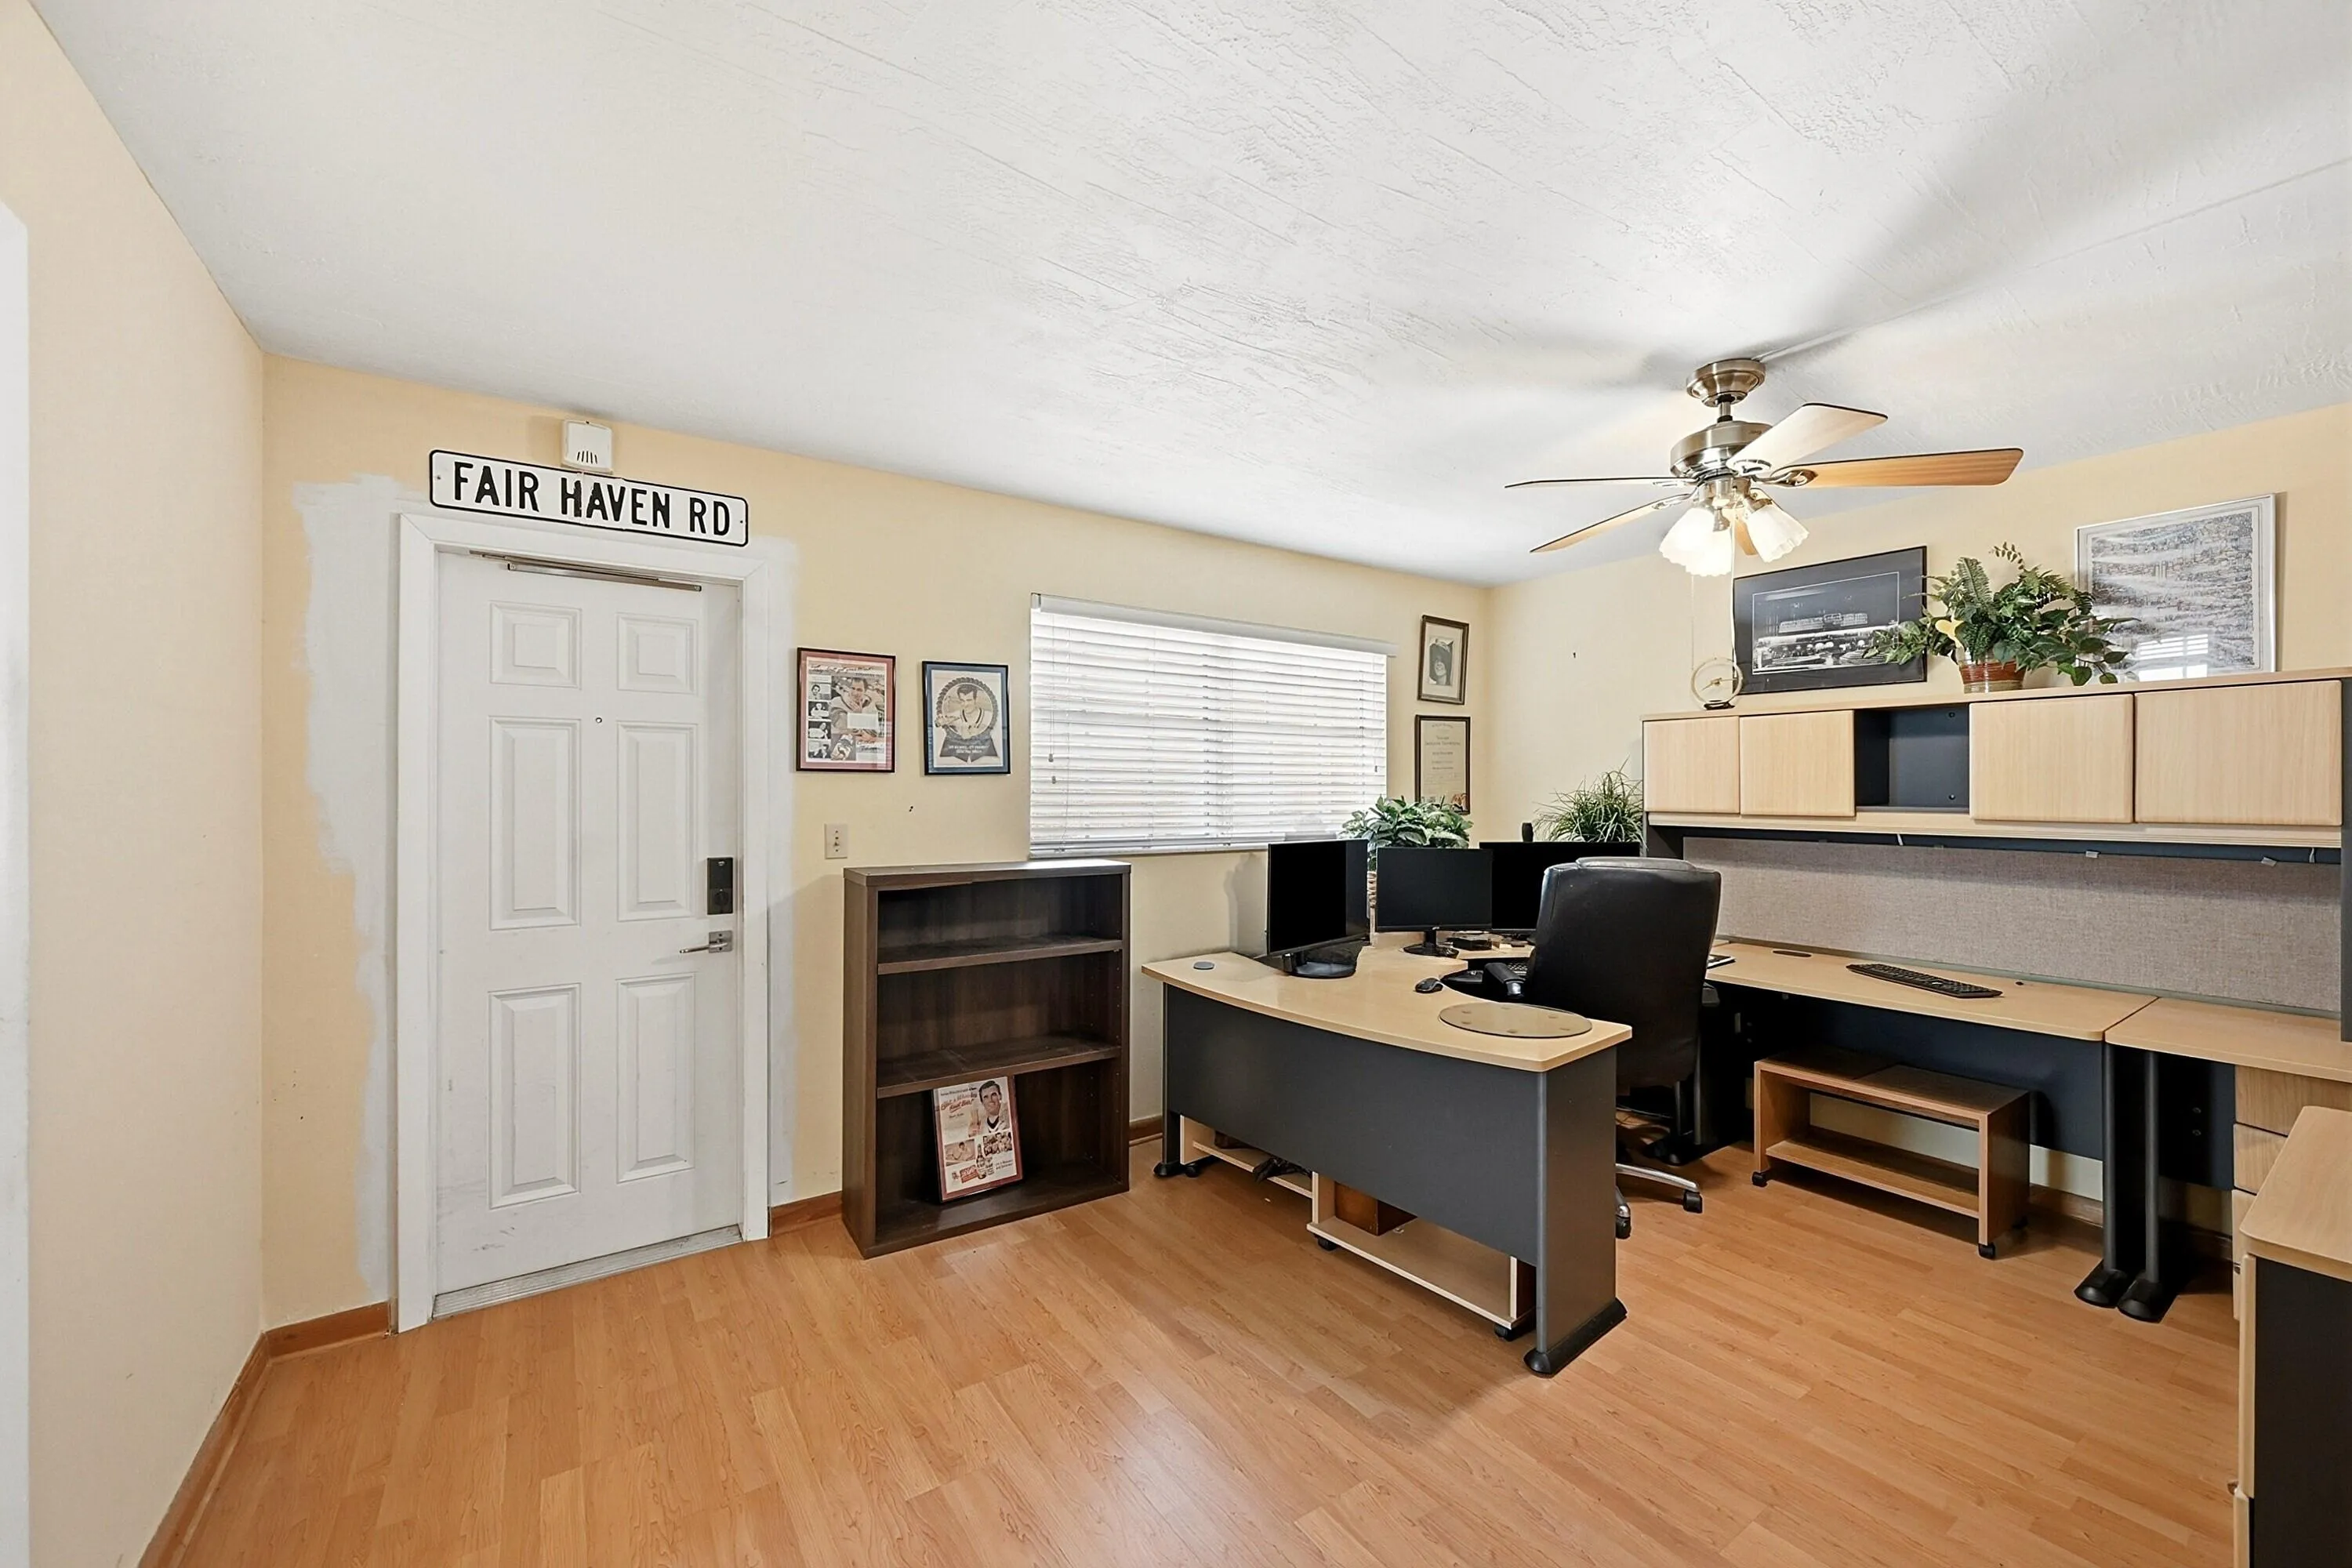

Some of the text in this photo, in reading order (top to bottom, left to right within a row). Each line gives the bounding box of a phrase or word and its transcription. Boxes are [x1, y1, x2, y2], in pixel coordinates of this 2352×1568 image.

[454, 461, 730, 536] FAIR HAVEN RD
